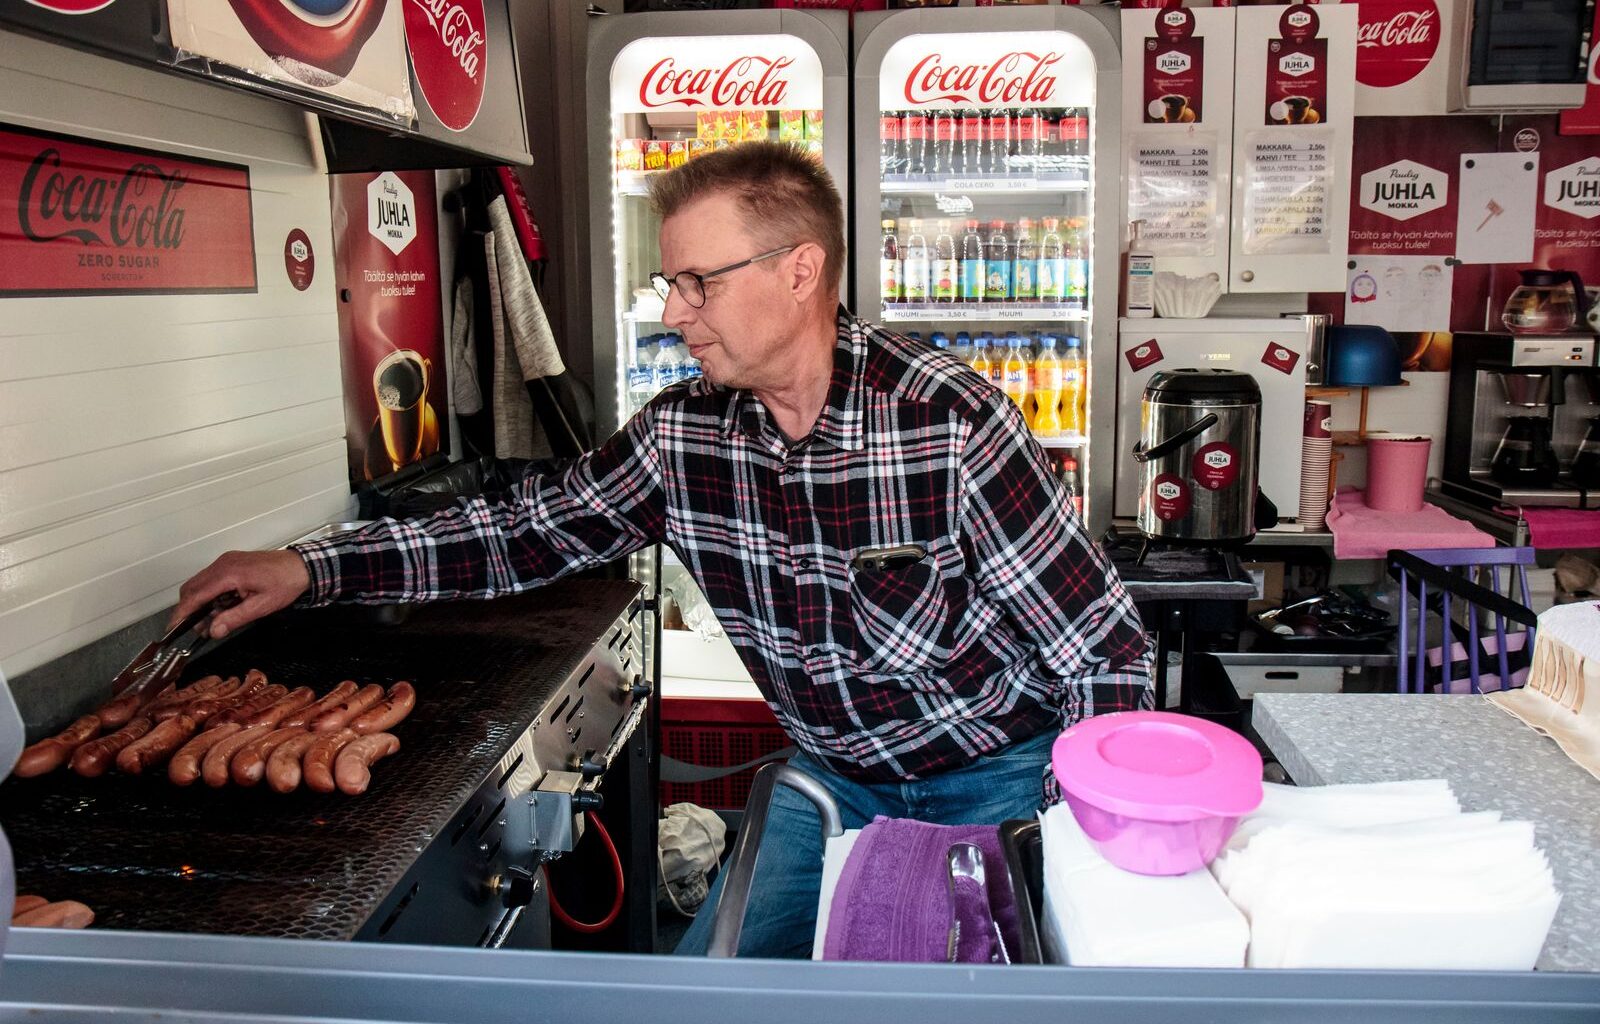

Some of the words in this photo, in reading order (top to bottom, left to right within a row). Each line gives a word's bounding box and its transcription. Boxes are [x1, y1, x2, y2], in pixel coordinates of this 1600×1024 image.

[1161, 59, 1187, 68] JUHLA
[1284, 60, 1310, 70] JUHLA
[639, 55, 797, 107] Coca-Cola
[904, 51, 1066, 104] Coca-Cola
[1167, 159, 1181, 167] TEE
[1389, 164, 1420, 180] Paulig
[954, 181, 974, 189] COLA
[1371, 182, 1436, 204] JUHLA
[1556, 180, 1600, 203] JUH
[18, 147, 191, 250] Coca-Cola
[376, 197, 411, 229] JUHLA
[1381, 231, 1392, 239] se
[1423, 230, 1454, 239] kahvin
[1565, 230, 1578, 238] se
[1372, 241, 1403, 250] tuoksu
[1404, 241, 1431, 249] tulee!
[77, 253, 114, 268] ZERO
[118, 255, 160, 270] SUGAR
